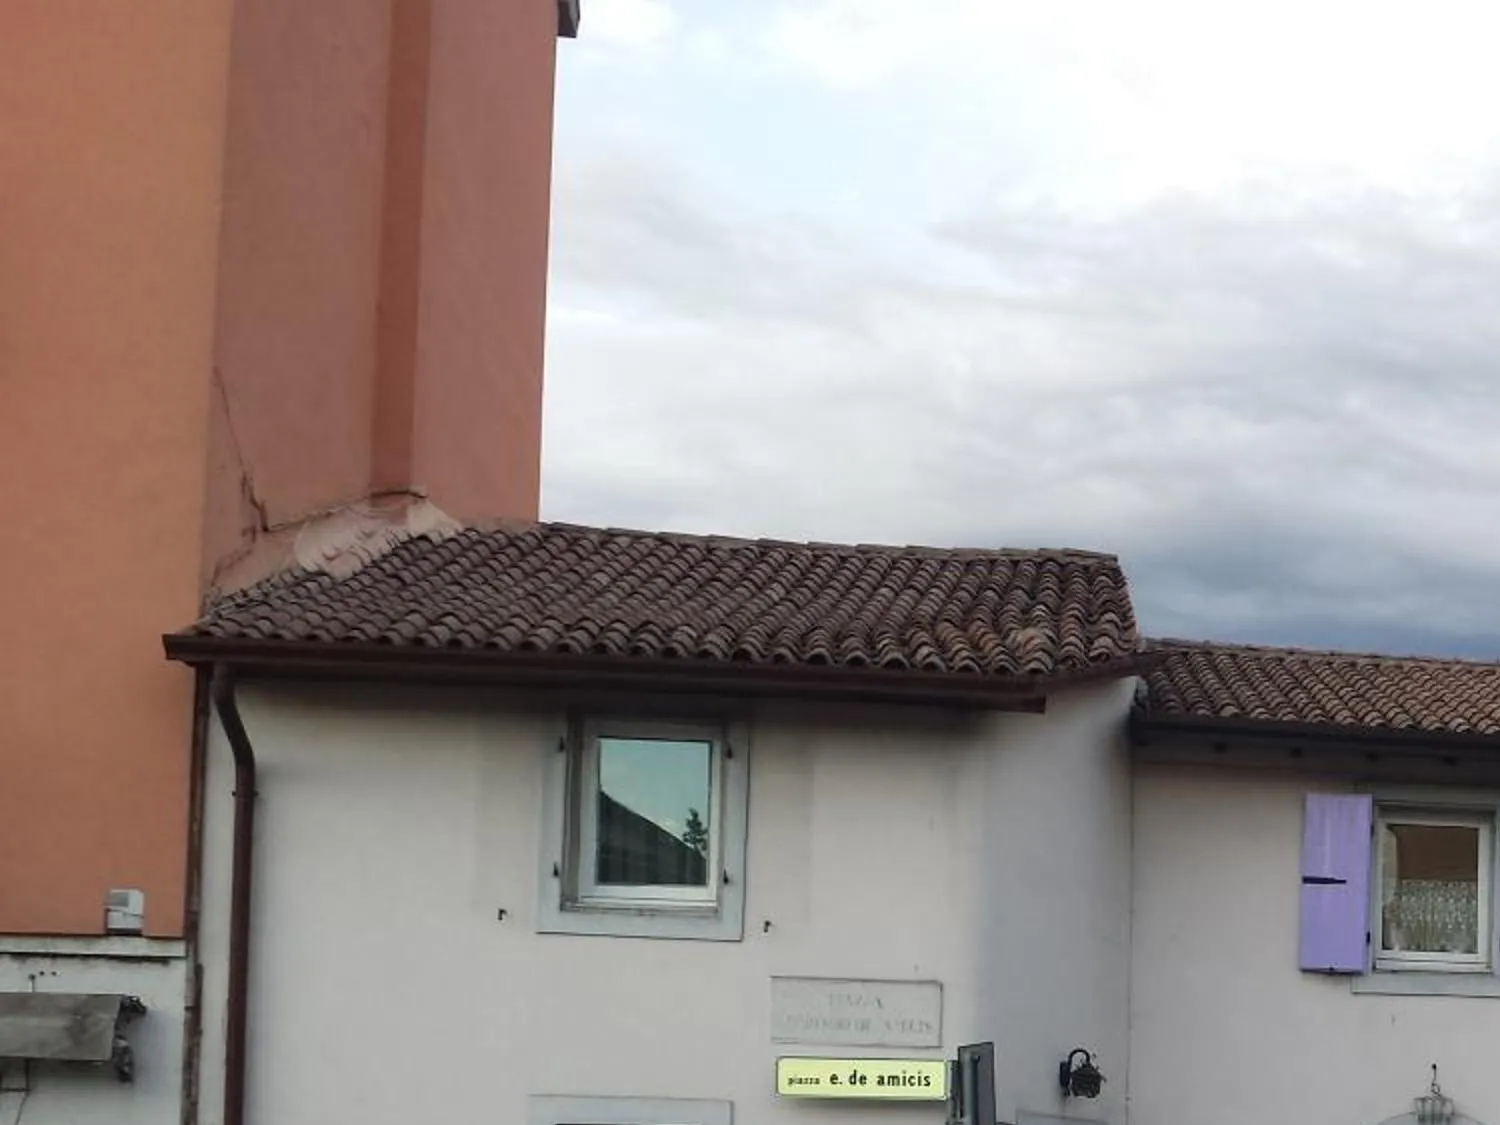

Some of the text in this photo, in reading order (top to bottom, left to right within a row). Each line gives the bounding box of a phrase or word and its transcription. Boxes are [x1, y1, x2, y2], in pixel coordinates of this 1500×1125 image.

[788, 1068, 931, 1087] piazza e. de amicis
